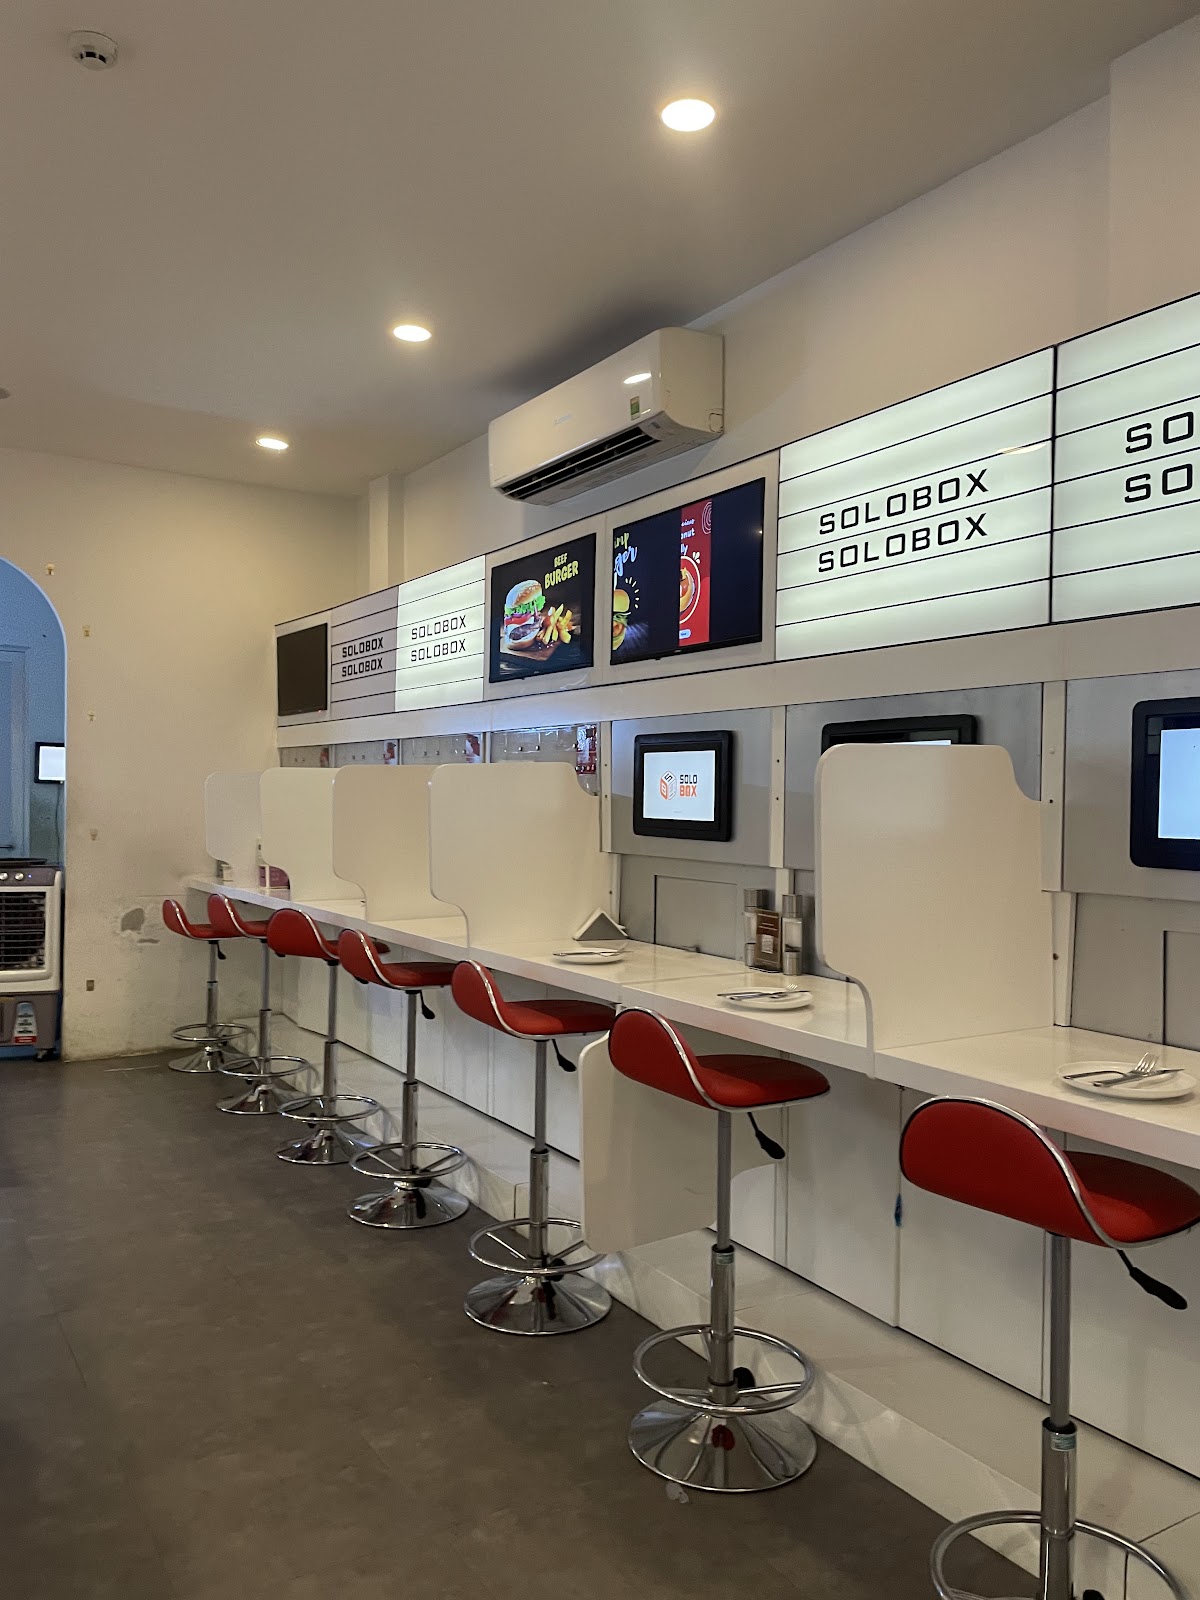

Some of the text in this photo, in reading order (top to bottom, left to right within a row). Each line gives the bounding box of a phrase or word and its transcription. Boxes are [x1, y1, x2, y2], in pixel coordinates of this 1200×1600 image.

[819, 468, 989, 535] SOLOBOX
[818, 512, 988, 573] SOLOBOX
[554, 552, 568, 567] BEEF
[544, 560, 579, 589] BURGER
[411, 615, 466, 640] SOLOBOX
[342, 636, 384, 658] SOLOBOX
[410, 638, 466, 662] SOLOBOX
[341, 657, 383, 677] SOLOBOX
[679, 774, 698, 784] SOLO
[679, 785, 697, 797] BOX
